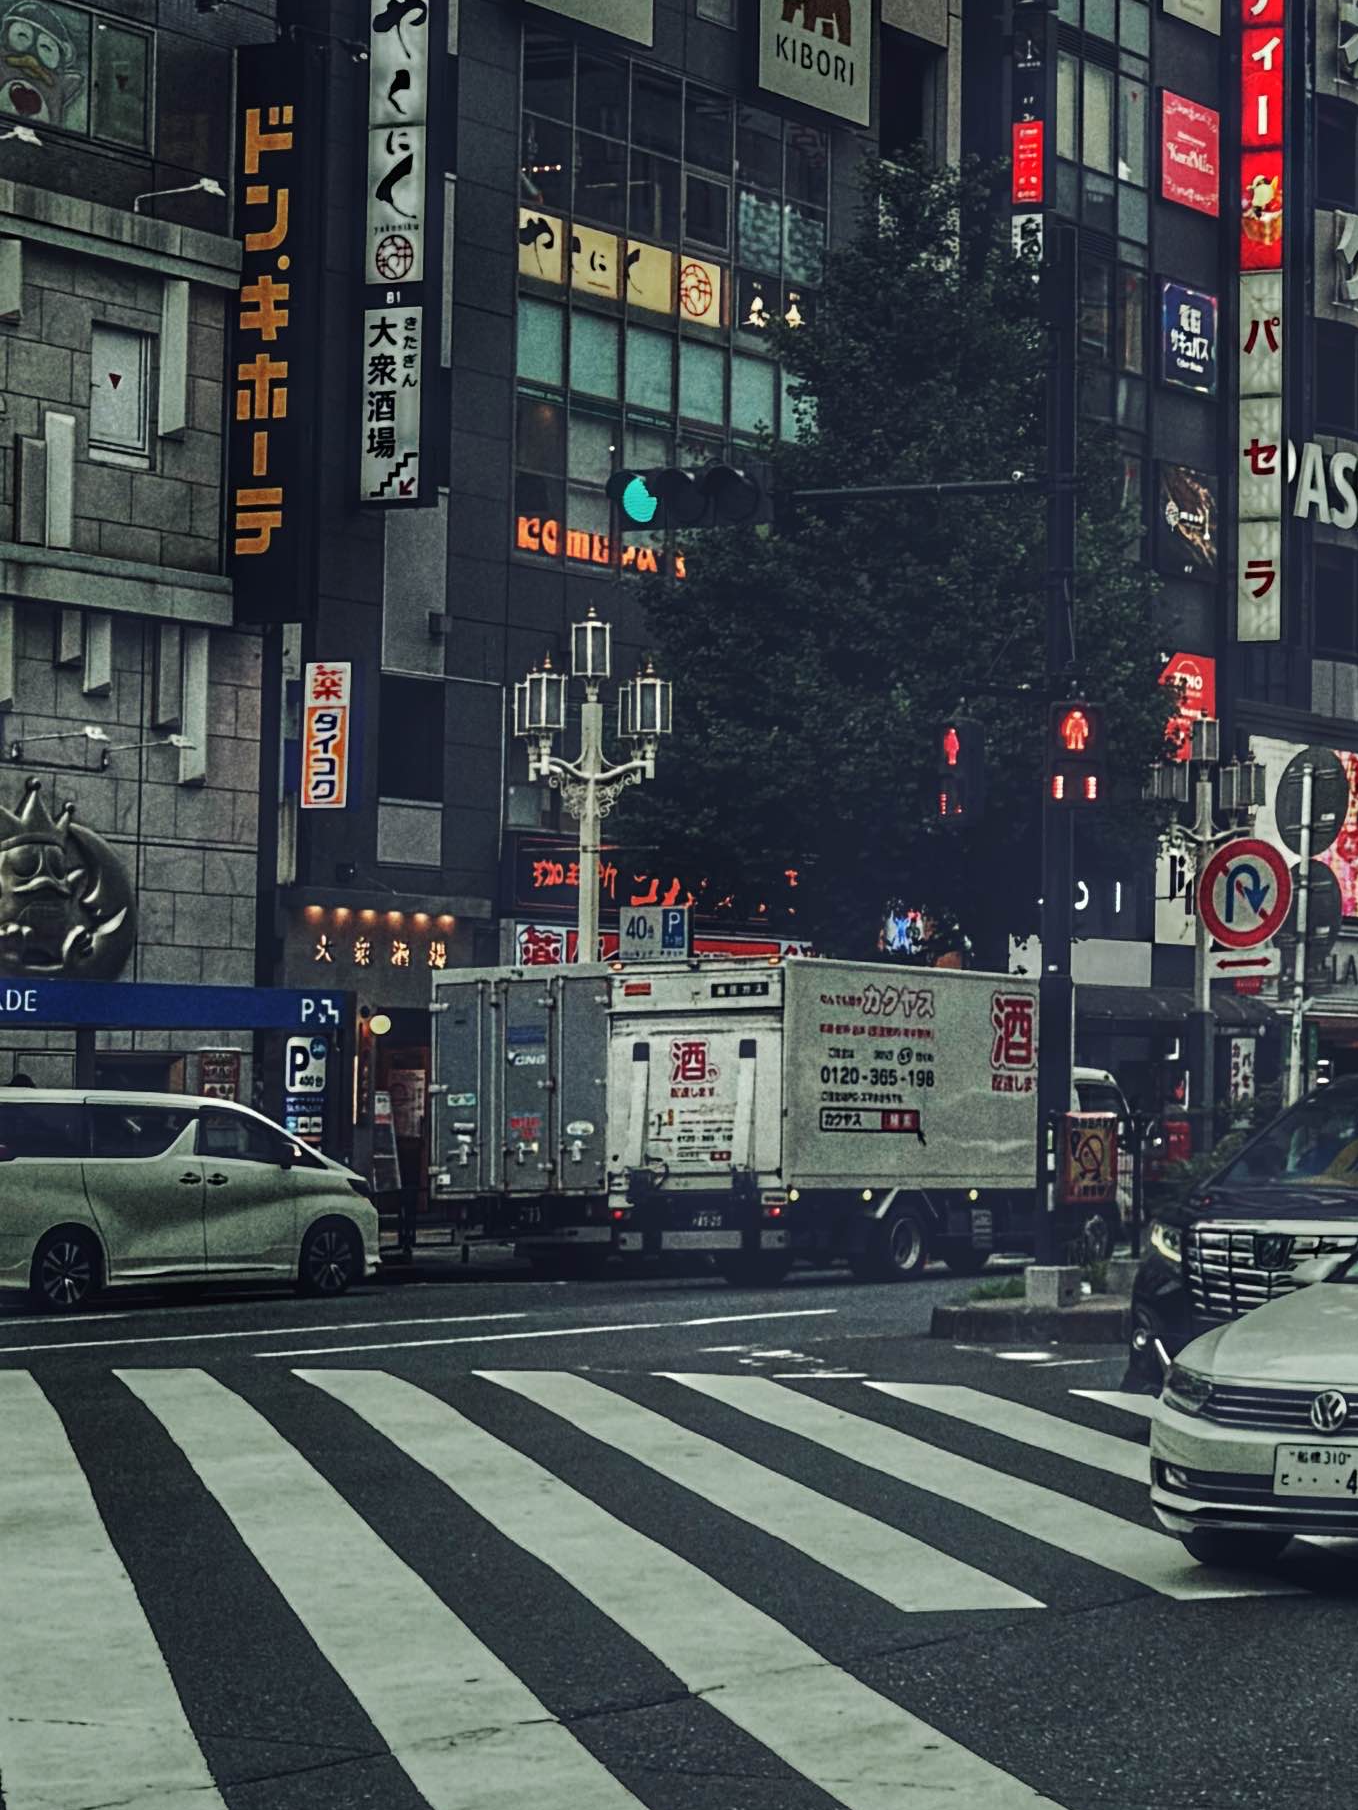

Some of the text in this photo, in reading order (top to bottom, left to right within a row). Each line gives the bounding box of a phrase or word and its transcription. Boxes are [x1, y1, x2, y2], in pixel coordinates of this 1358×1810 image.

[773, 31, 856, 88] KIBORI
[233, 104, 296, 557] ドン・キホーテ
[365, 315, 398, 460] 大衆酒場
[1242, 317, 1283, 598] パセラ
[312, 664, 343, 702] 薬
[311, 710, 340, 803] タイコク
[669, 914, 681, 931] P
[288, 1043, 310, 1088] P
[820, 1066, 936, 1089] 0120-365-198
[823, 1111, 862, 1127] カクヤス
